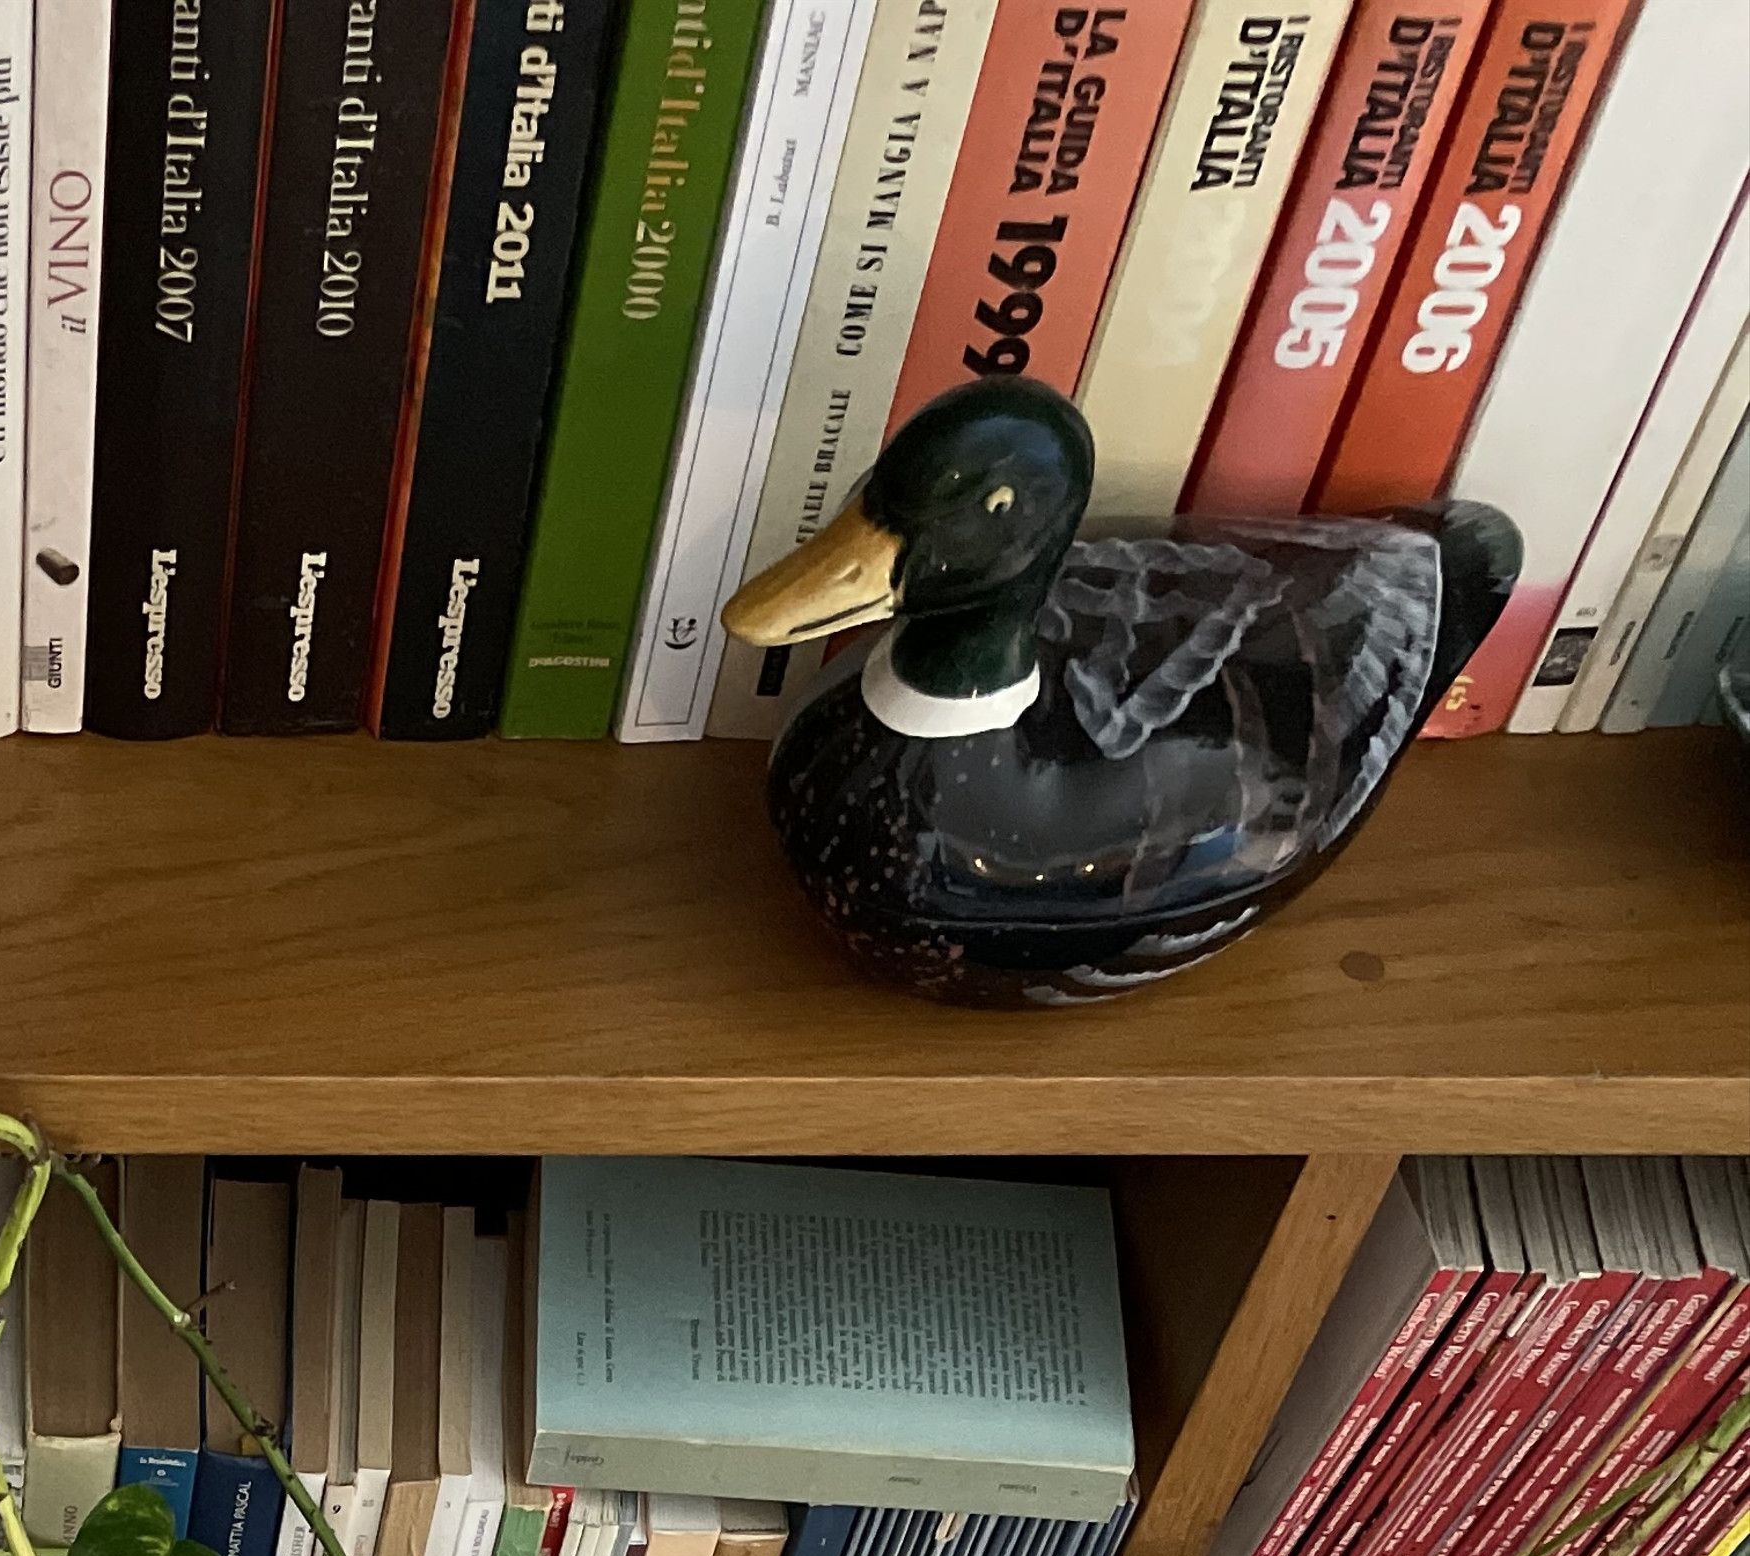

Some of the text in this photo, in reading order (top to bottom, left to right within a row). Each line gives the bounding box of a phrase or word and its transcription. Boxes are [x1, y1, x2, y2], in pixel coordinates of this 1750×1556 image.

[161, 94, 207, 237] d'Italia
[326, 97, 378, 238] d'Italia
[503, 45, 556, 187] d'Italia
[1008, 8, 1088, 194] D'ITALIA
[1046, 8, 1127, 195] LA GUIDA
[1189, 17, 1282, 191] D'ITALIA
[1232, 31, 1305, 189] RISTORANTI
[1334, 17, 1434, 190] D'ITALIA
[1464, 22, 1566, 195] D'ITALIA
[47, 170, 92, 334] il VINO
[486, 202, 534, 303] 2011
[622, 50, 706, 319] d'Italia 2000
[155, 246, 199, 343] 2007
[315, 250, 362, 337] 2010
[813, 79, 929, 473] BRACALE COME SI MANGIA A
[962, 214, 1069, 377] 1999
[1274, 197, 1391, 369] 2005
[1402, 202, 1522, 373] 2006
[49, 636, 63, 689] GIUNTI
[143, 549, 178, 701] L'espresso
[287, 552, 327, 703] L'espresso
[432, 559, 481, 719] L'espresso
